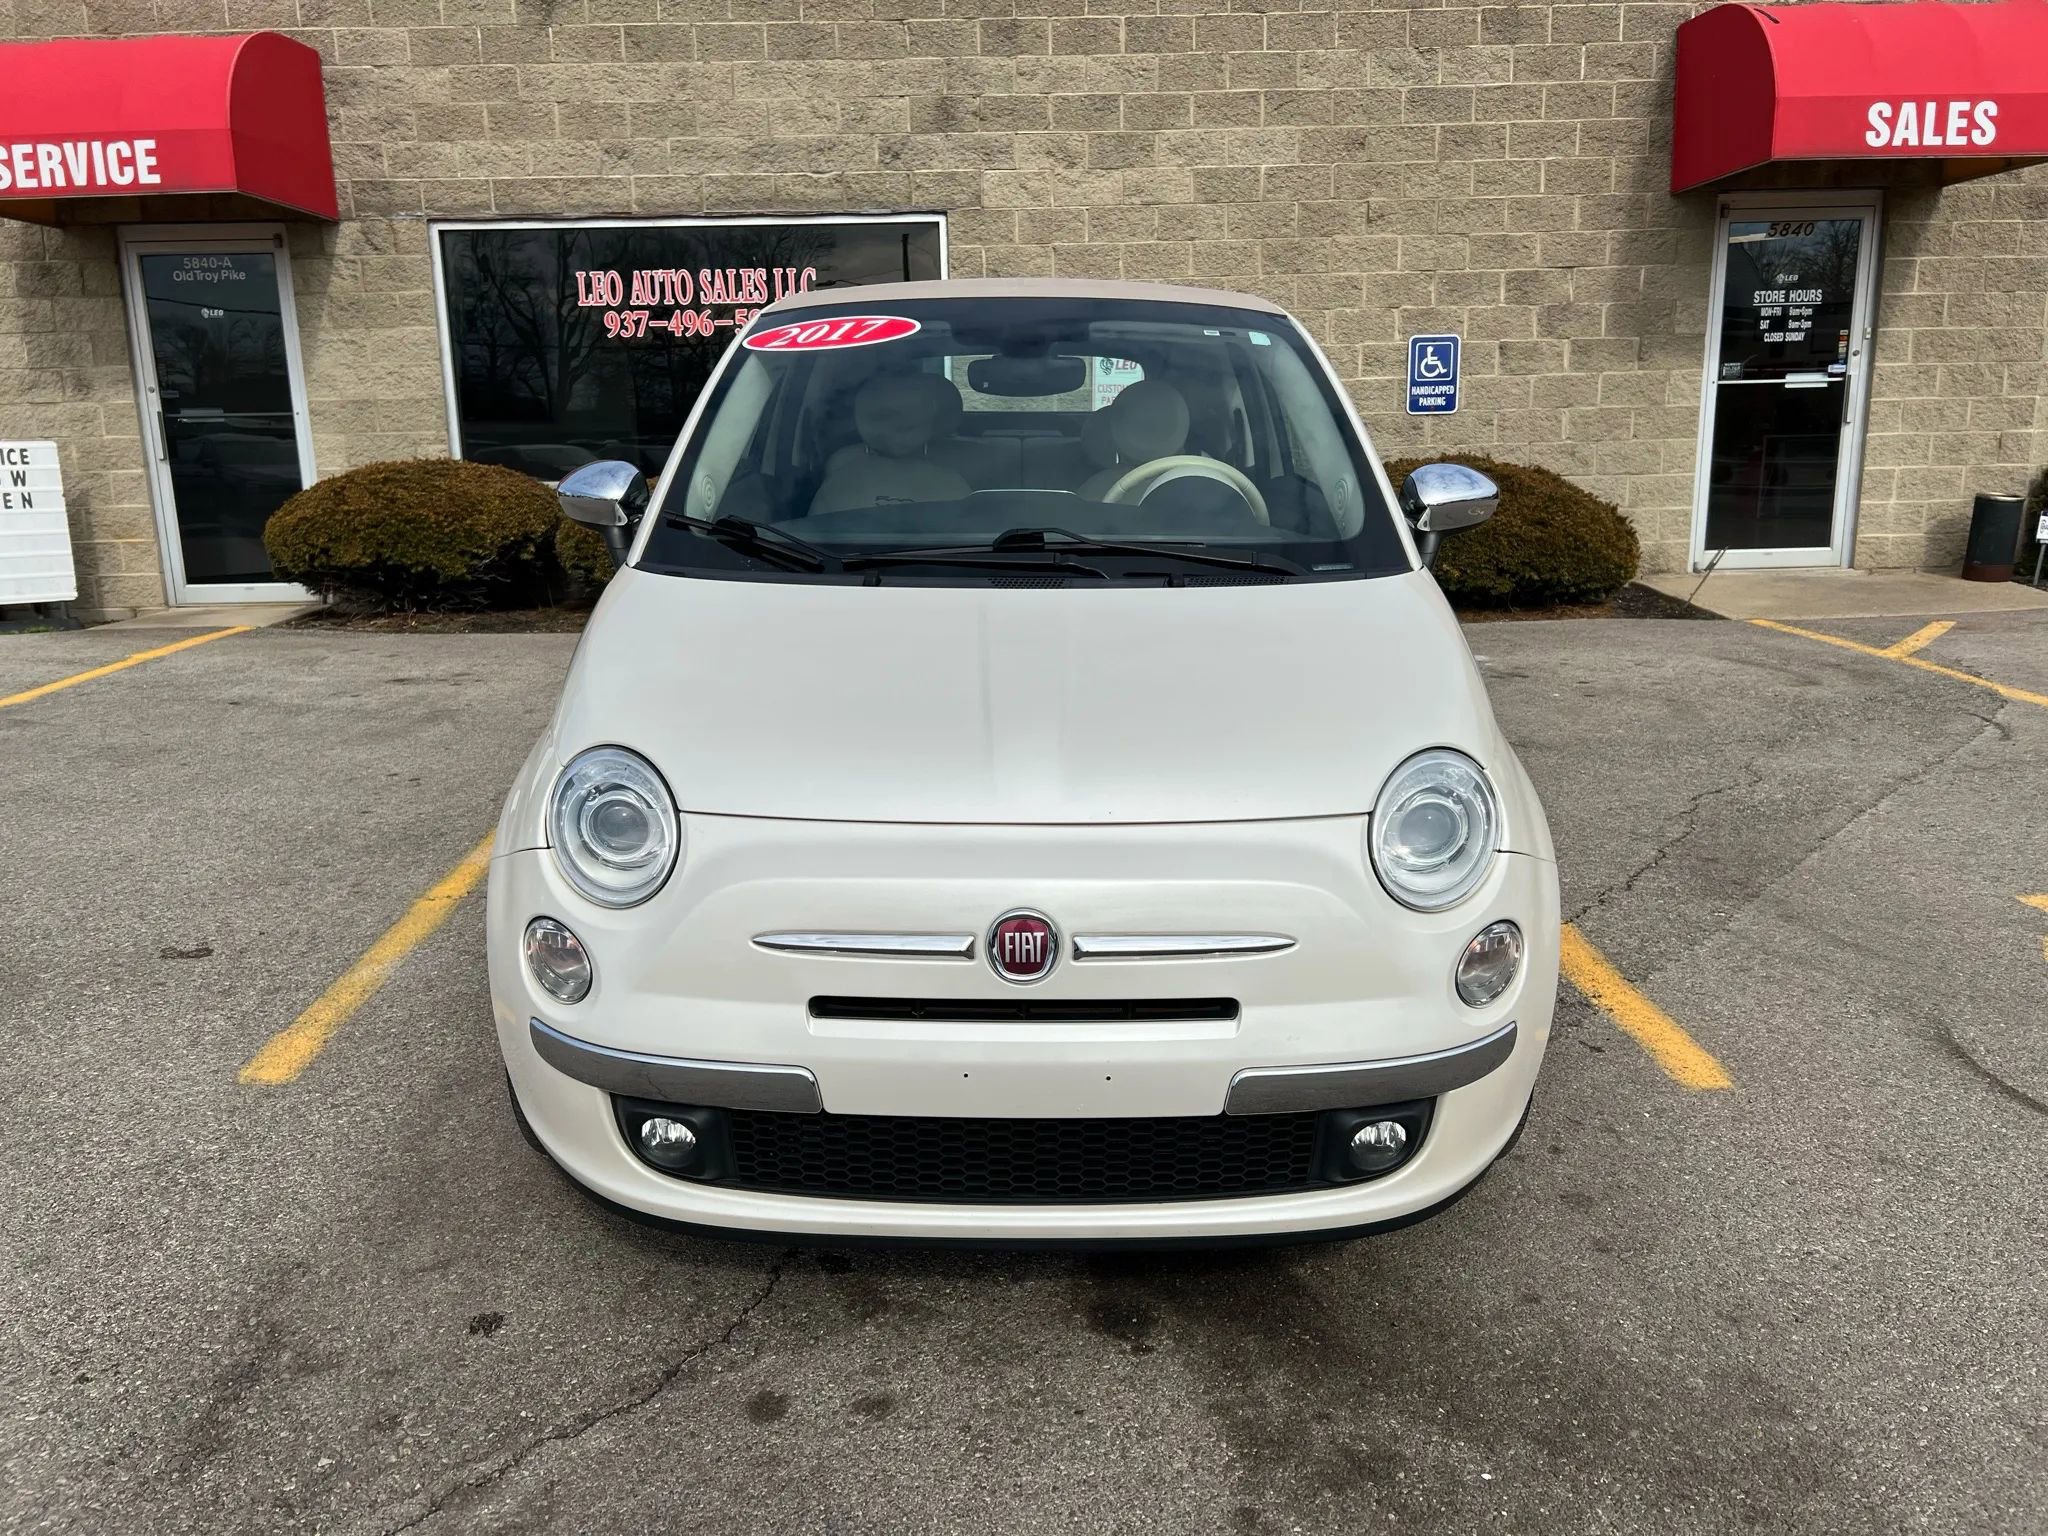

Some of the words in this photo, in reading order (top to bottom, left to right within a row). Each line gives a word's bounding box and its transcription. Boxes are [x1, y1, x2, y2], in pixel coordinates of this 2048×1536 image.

[1865, 100, 1998, 147] SALES
[0, 139, 161, 190] SERVICE
[1768, 222, 1815, 238] 5840
[183, 257, 232, 269] 5840-A
[173, 271, 194, 281] Old
[194, 270, 219, 283] Troy
[221, 270, 246, 280] Pike
[576, 270, 624, 306] LEO
[630, 269, 693, 305] AUTO
[699, 268, 768, 304] SALES
[773, 267, 817, 303] LLC
[1753, 291, 1785, 303] STORE
[1789, 289, 1823, 302] HOURS
[209, 309, 224, 317] LEO
[1761, 307, 1782, 317] MON-FRI
[1760, 320, 1770, 330] SAT
[764, 319, 889, 348] 2017
[1764, 332, 1784, 342] CLOSED
[1785, 331, 1806, 342] SUNDAY
[1114, 359, 1137, 370] LEO
[1411, 385, 1455, 395] HANDICAPPED
[1418, 397, 1446, 406] PARKING
[1004, 931, 1045, 963] FIAT
